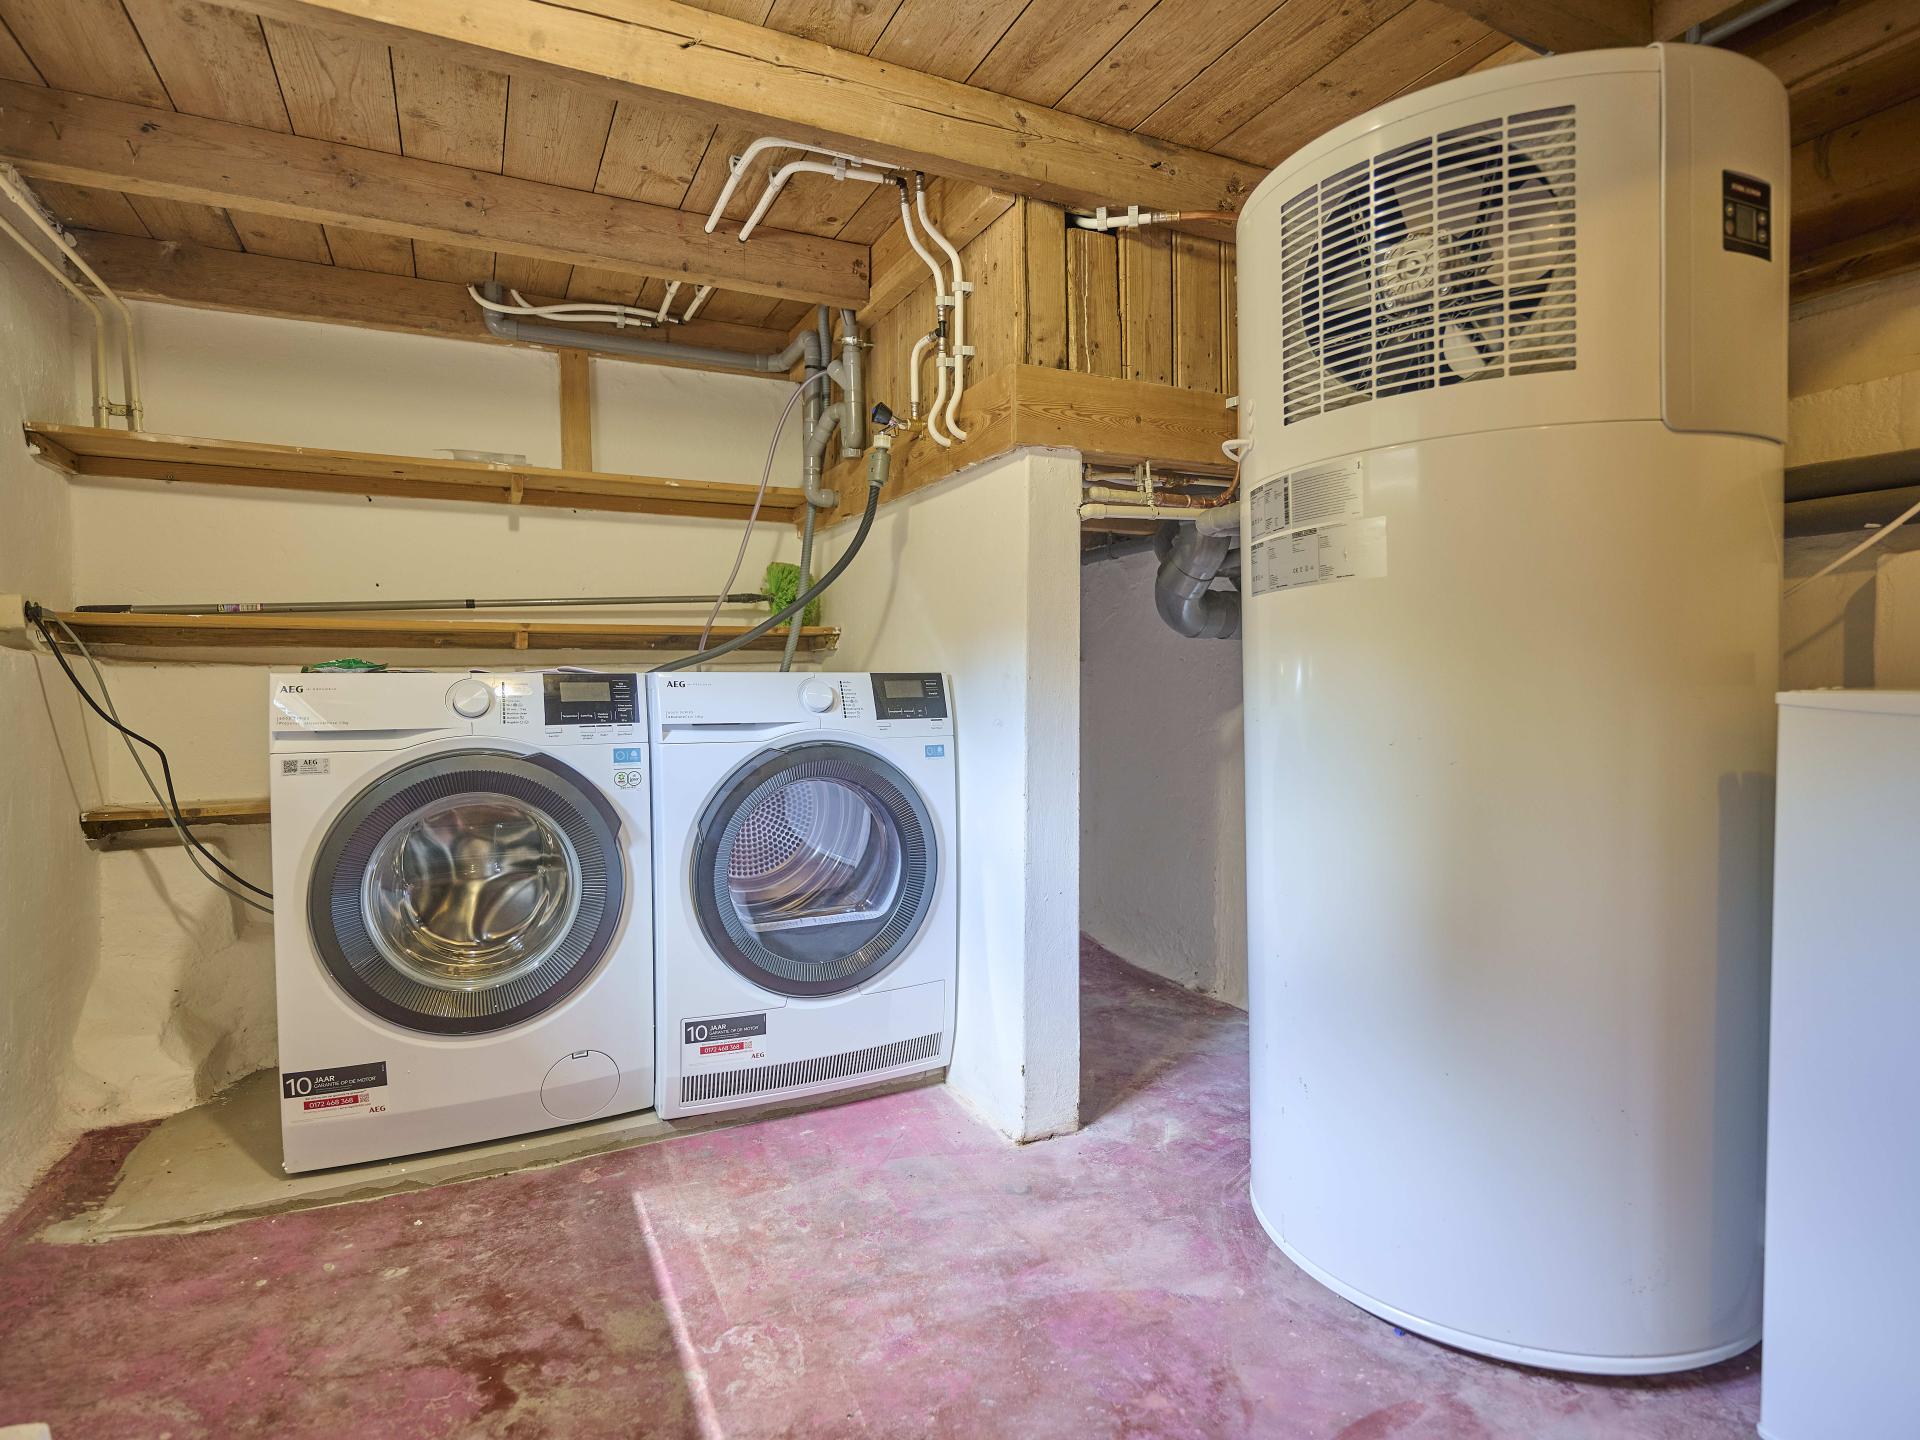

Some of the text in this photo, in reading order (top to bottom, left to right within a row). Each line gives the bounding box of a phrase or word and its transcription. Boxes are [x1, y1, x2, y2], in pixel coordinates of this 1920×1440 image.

[666, 680, 686, 688] AEG
[686, 1025, 708, 1042] 10
[729, 1043, 740, 1051] 368
[314, 1075, 335, 1084] JAAR
[286, 1077, 312, 1096] 10
[313, 1081, 340, 1089] GARANTIE
[326, 1099, 340, 1107] 468
[341, 1097, 354, 1105] 368
